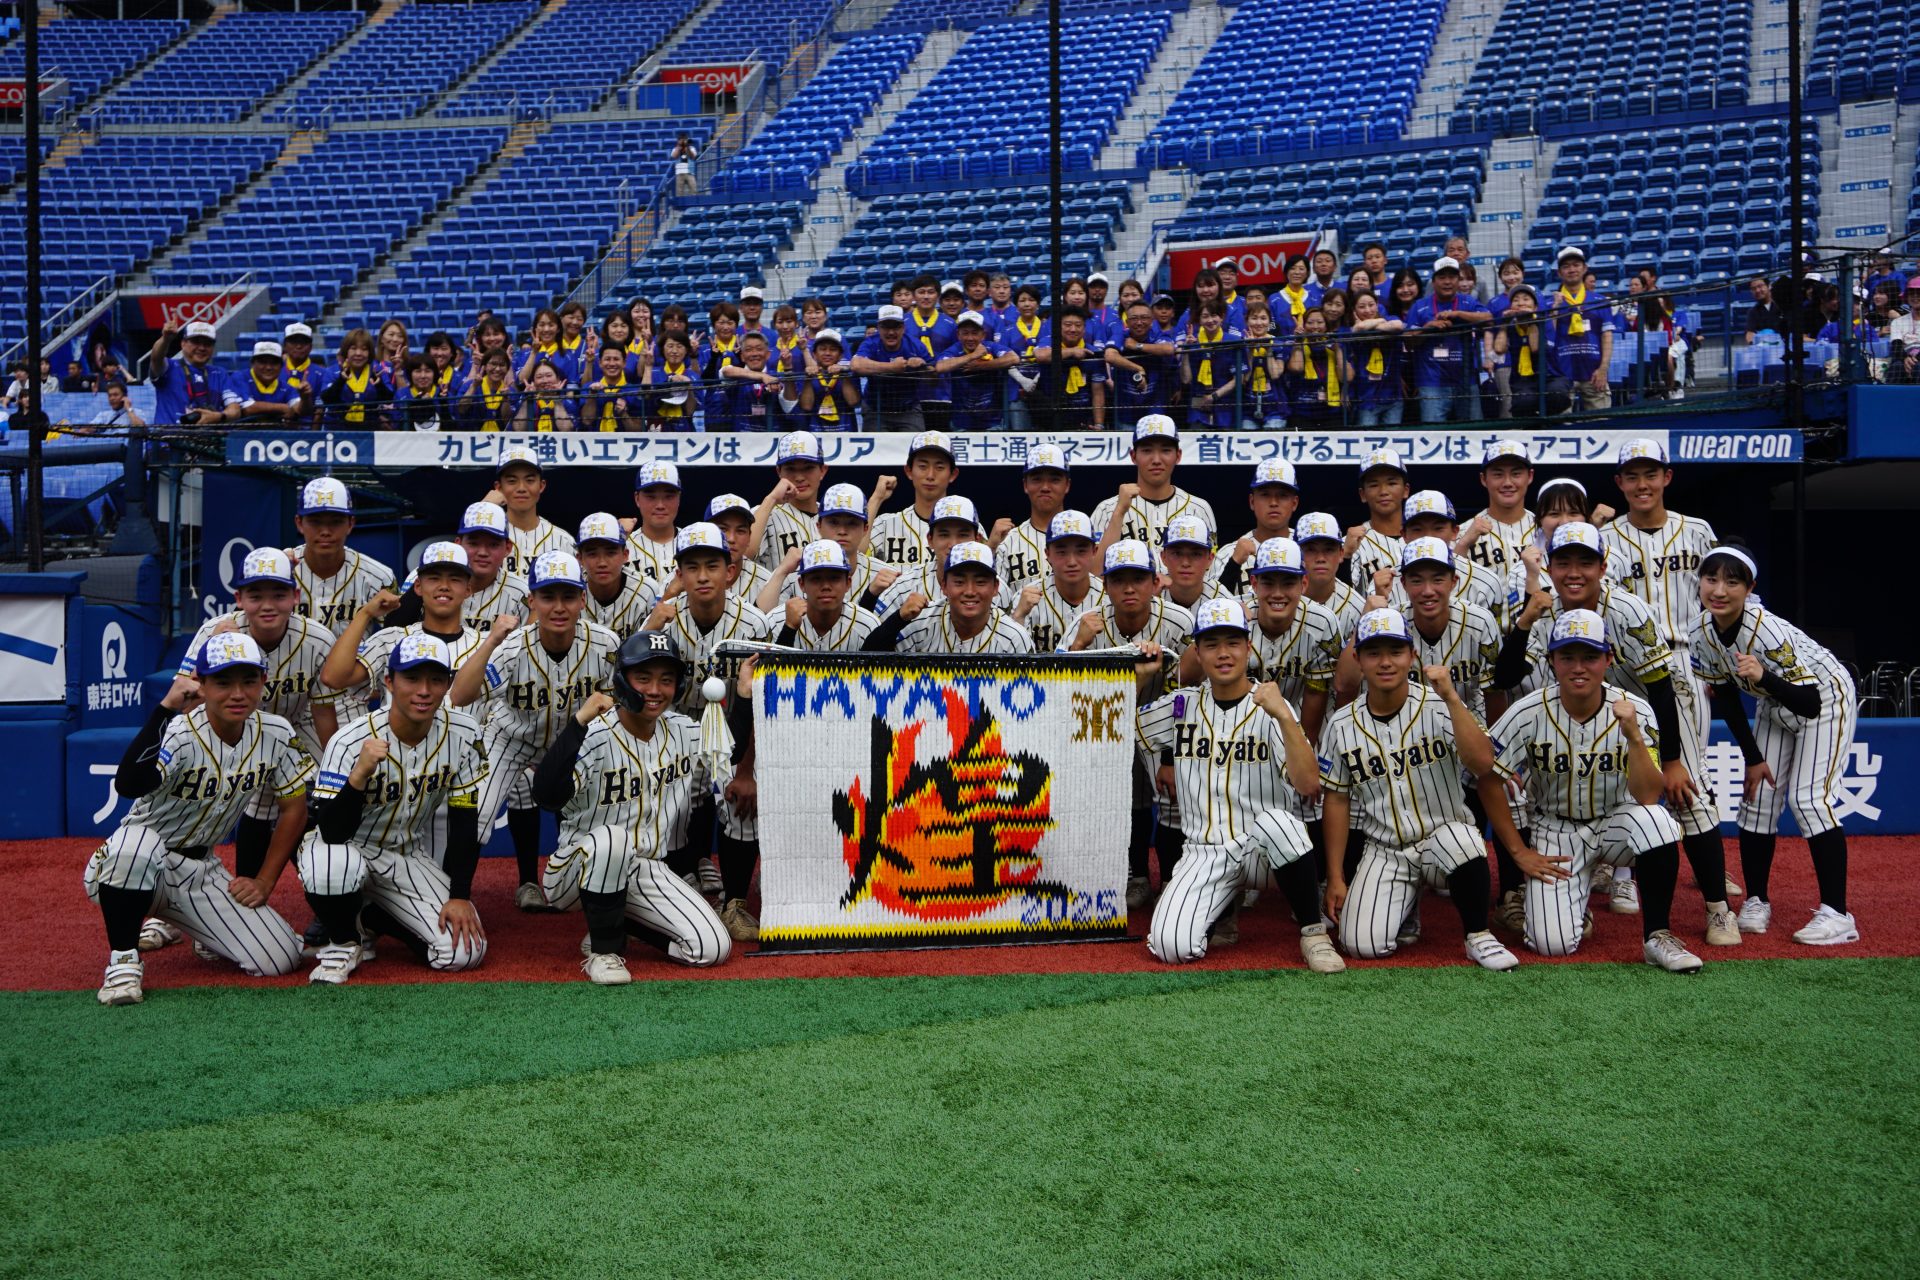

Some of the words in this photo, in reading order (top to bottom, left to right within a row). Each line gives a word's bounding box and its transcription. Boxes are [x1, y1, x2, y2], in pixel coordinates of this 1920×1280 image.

[244, 433, 357, 463] nocria
[754, 436, 875, 462] ノリア
[1482, 434, 1609, 462] アコン
[1631, 550, 1700, 580] ayato
[298, 599, 356, 626] ayat
[87, 681, 142, 710] 東洋ロザイ
[763, 674, 1045, 721] HAYATO
[1174, 723, 1269, 767] Hayato
[1341, 737, 1447, 785] Hayato
[600, 754, 691, 805] Hayato
[1020, 890, 1117, 926] 2025
